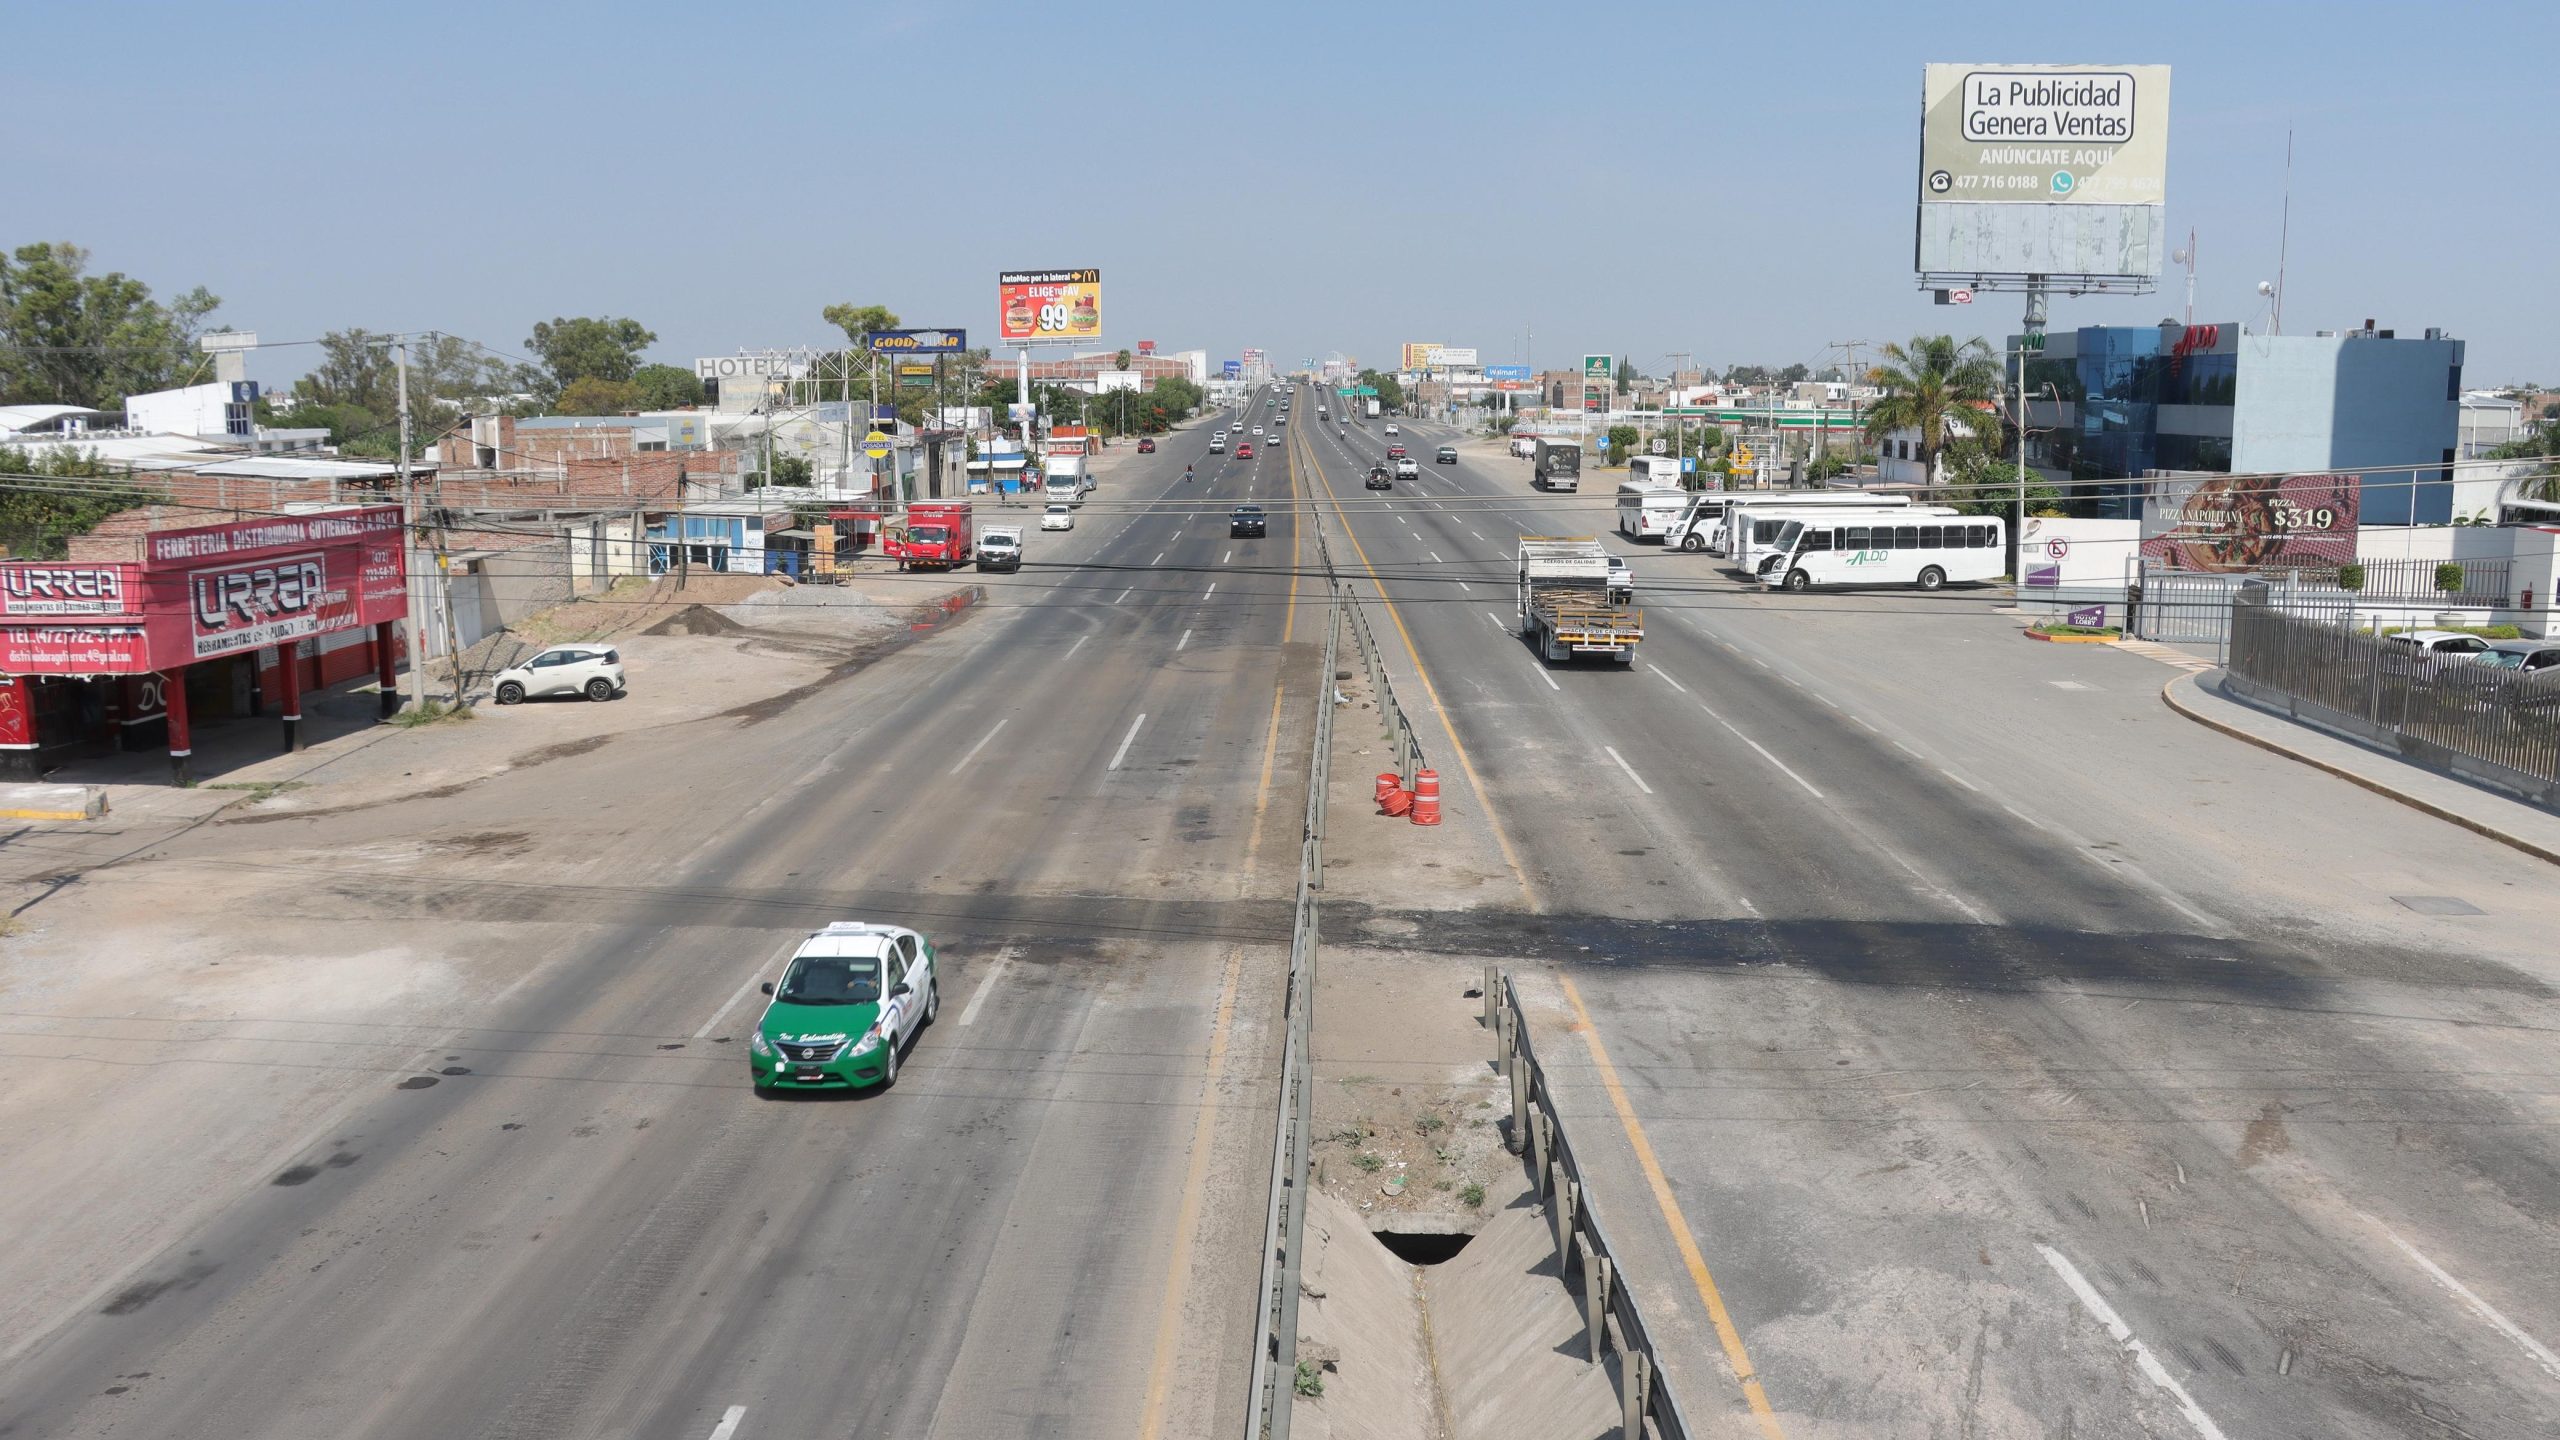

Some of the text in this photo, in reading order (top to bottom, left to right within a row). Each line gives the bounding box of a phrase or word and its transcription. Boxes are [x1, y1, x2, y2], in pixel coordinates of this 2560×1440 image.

[1977, 80, 2120, 106] La Publicidad
[1969, 111, 2126, 136] Genera Ventas
[1980, 146, 2112, 166] ANÚNCIATE AQUÍ
[1955, 176, 2038, 189] 477 716 0188
[1001, 273, 1071, 284] AutoMac por la lateral
[1029, 286, 1054, 298] ELIGE
[1055, 288, 1063, 296] TU
[1063, 286, 1079, 297] FAV
[1036, 303, 1068, 331] $99
[874, 336, 959, 349] GOODAR
[700, 358, 785, 377] HOTEL
[1489, 368, 1517, 377] Walmart
[2269, 499, 2295, 507] PIZZA
[2160, 508, 2243, 523] PIZZA NAPOLITANA
[2274, 508, 2332, 529] $319
[156, 532, 228, 560] FERRETERIA
[232, 523, 306, 551] DISTRIBUIDORA
[309, 516, 361, 539] GUTIERREZ
[1846, 551, 1888, 565] ALDO
[9, 568, 117, 597] URREA
[197, 561, 322, 628] URREA
[8, 603, 54, 611] HERRAMIENTAS
